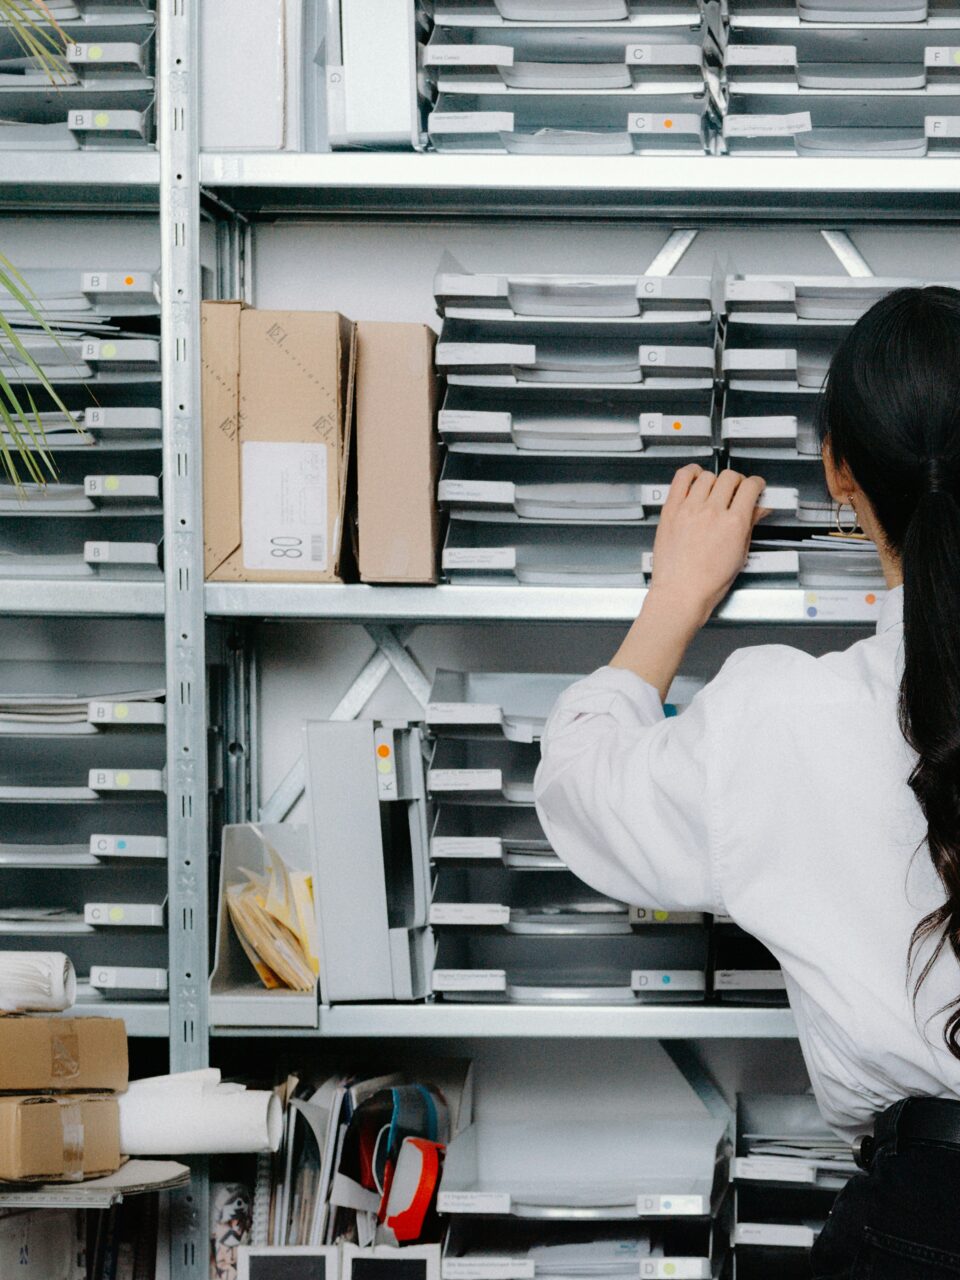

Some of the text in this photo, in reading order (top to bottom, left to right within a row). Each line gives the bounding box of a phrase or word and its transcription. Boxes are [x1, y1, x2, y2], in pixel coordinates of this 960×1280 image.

[75, 46, 82, 56] B
[633, 48, 643, 60] C
[934, 52, 940, 61] F
[330, 72, 342, 83] G
[75, 115, 84, 125] B
[635, 117, 645, 129] C
[933, 121, 941, 132] F
[91, 276, 100, 287] B
[644, 282, 655, 294] C
[87, 344, 94, 354] B
[647, 351, 657, 362] C
[92, 411, 99, 422] B
[89, 479, 97, 490] B
[652, 489, 662, 501] D
[93, 547, 101, 557] B
[270, 535, 303, 560] 80
[97, 707, 105, 718] B
[97, 773, 106, 784] B
[383, 782, 392, 791] K
[97, 839, 107, 851] C
[91, 908, 101, 920] C
[637, 908, 646, 919] D
[98, 971, 108, 983] C
[639, 975, 649, 986] D
[644, 1198, 654, 1210] D
[644, 1263, 654, 1274] D
